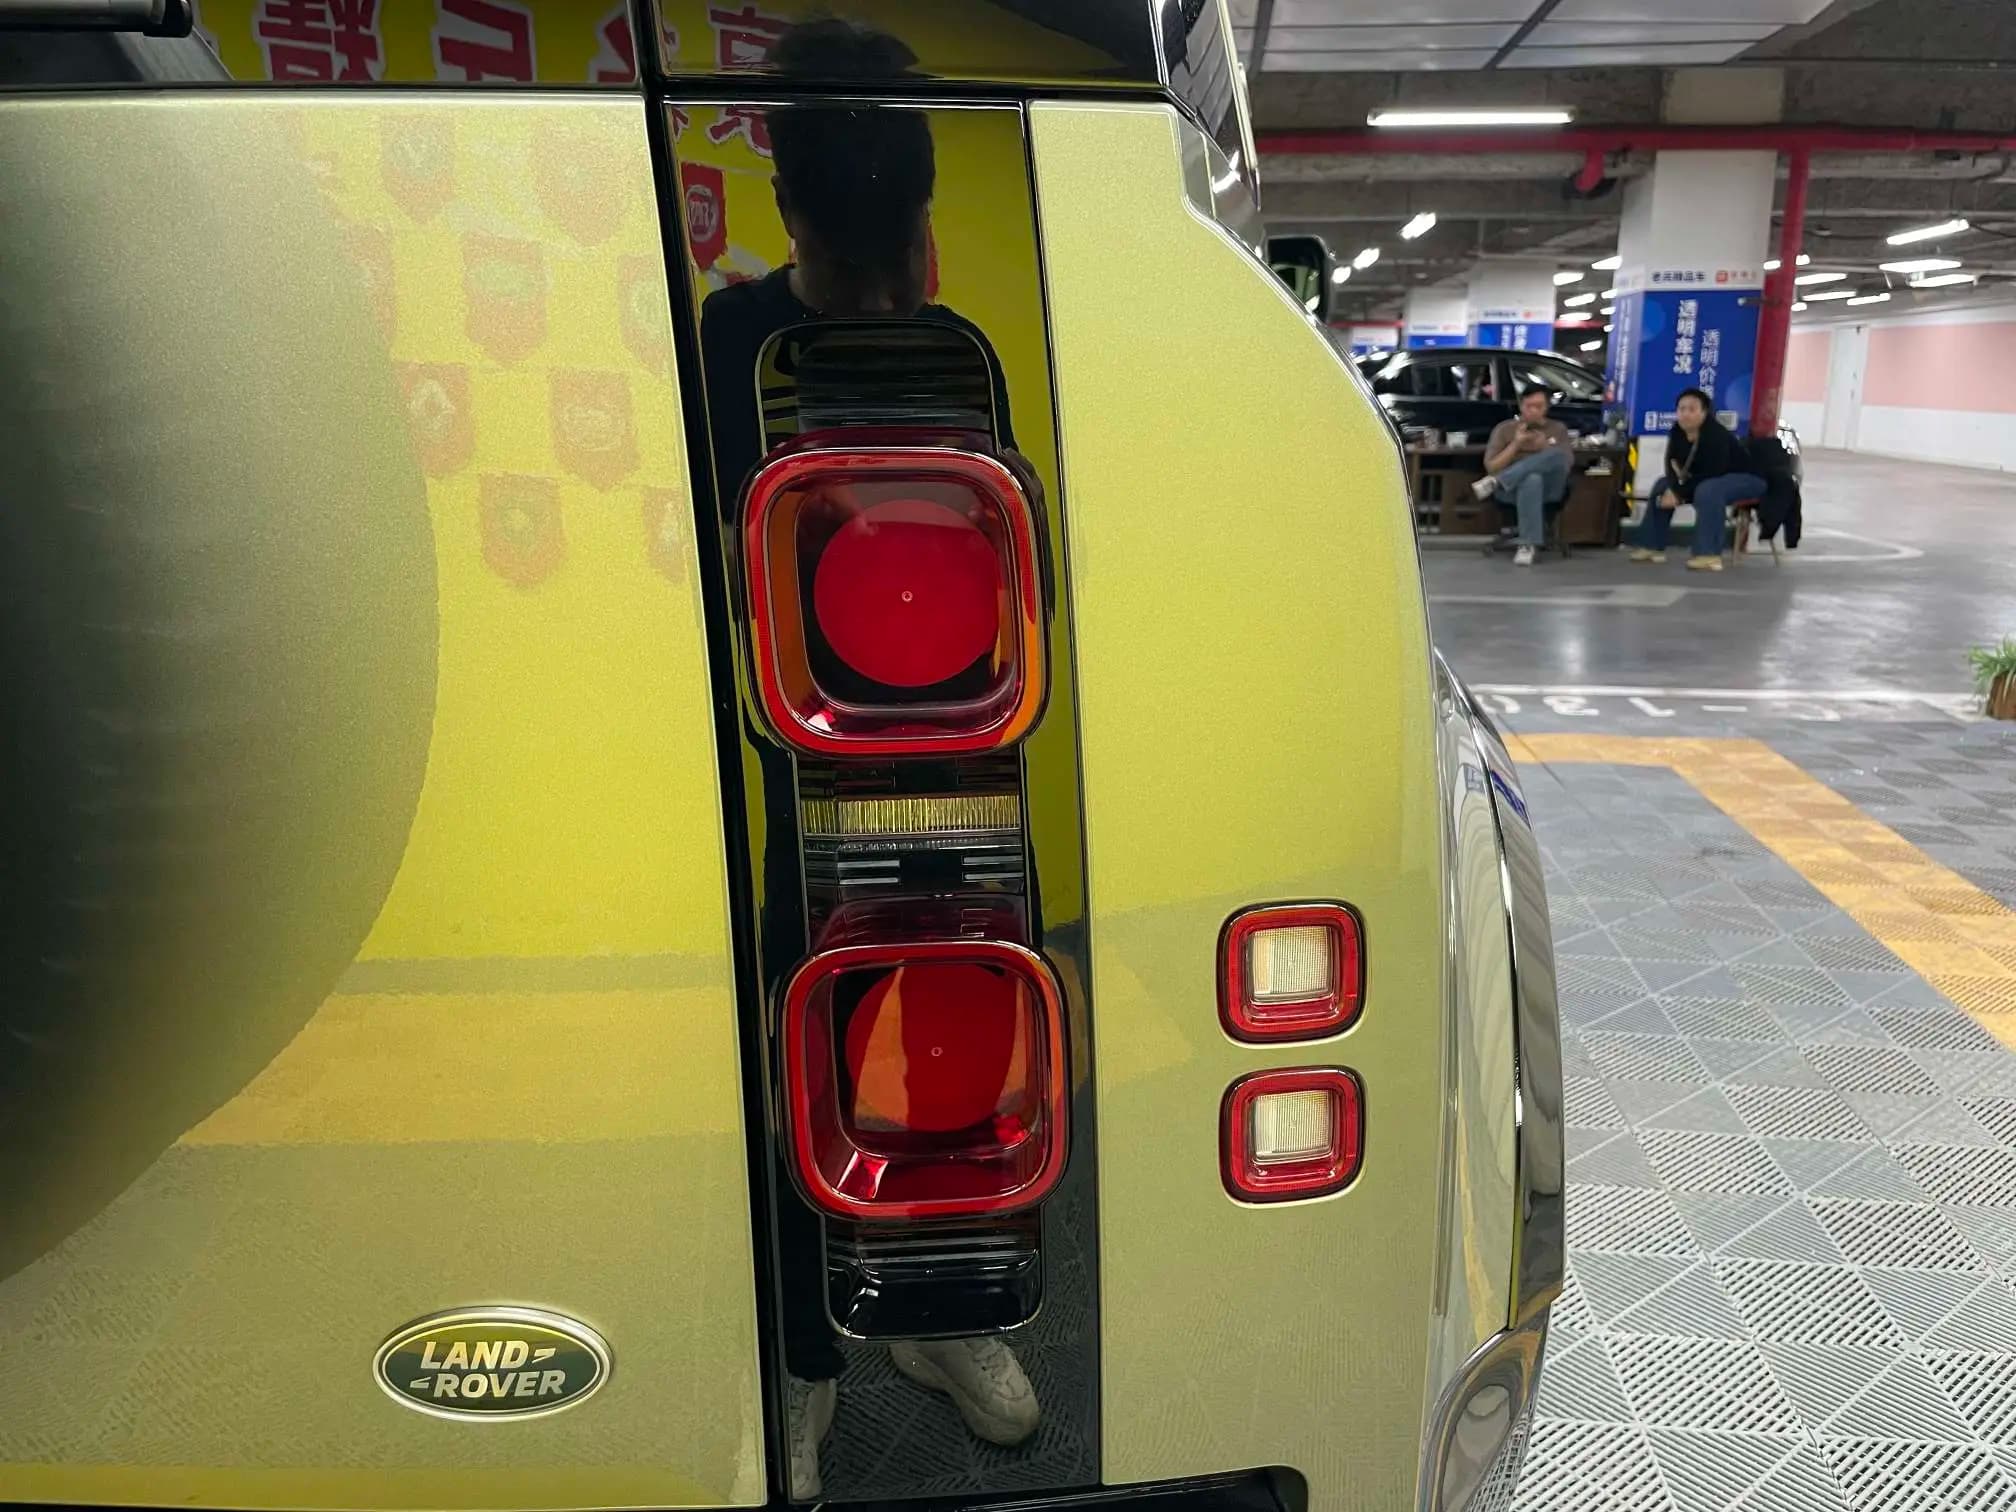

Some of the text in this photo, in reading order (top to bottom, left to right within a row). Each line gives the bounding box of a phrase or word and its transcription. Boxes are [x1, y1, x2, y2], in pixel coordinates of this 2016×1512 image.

[1673, 299, 1697, 374] 透明车况
[420, 1341, 529, 1370] LAND
[433, 1370, 566, 1398] ROVER
